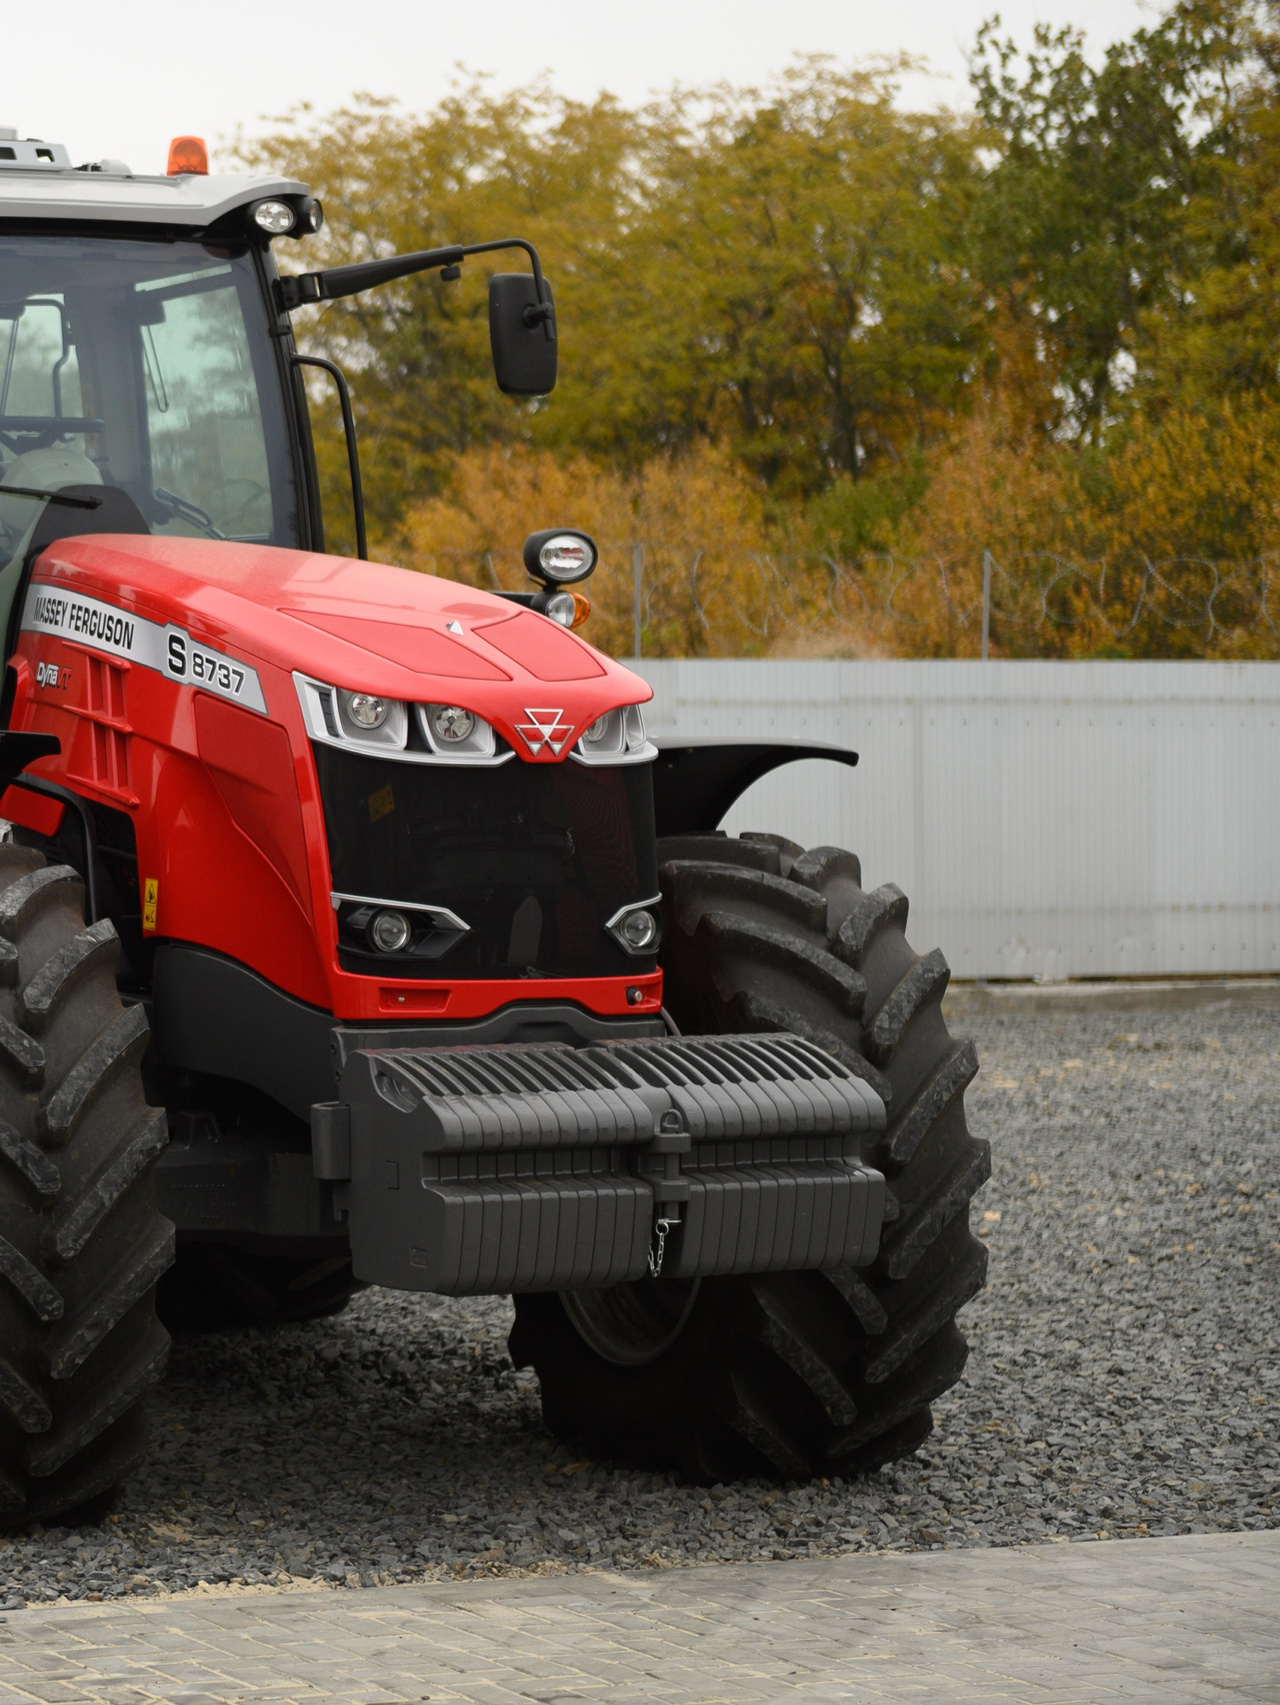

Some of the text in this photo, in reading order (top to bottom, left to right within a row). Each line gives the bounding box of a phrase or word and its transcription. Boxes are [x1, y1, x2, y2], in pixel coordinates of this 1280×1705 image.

[33, 596, 135, 650] MASSEY FERGUSON
[36, 661, 72, 690] DynaVT
[167, 633, 245, 695] S 8737
